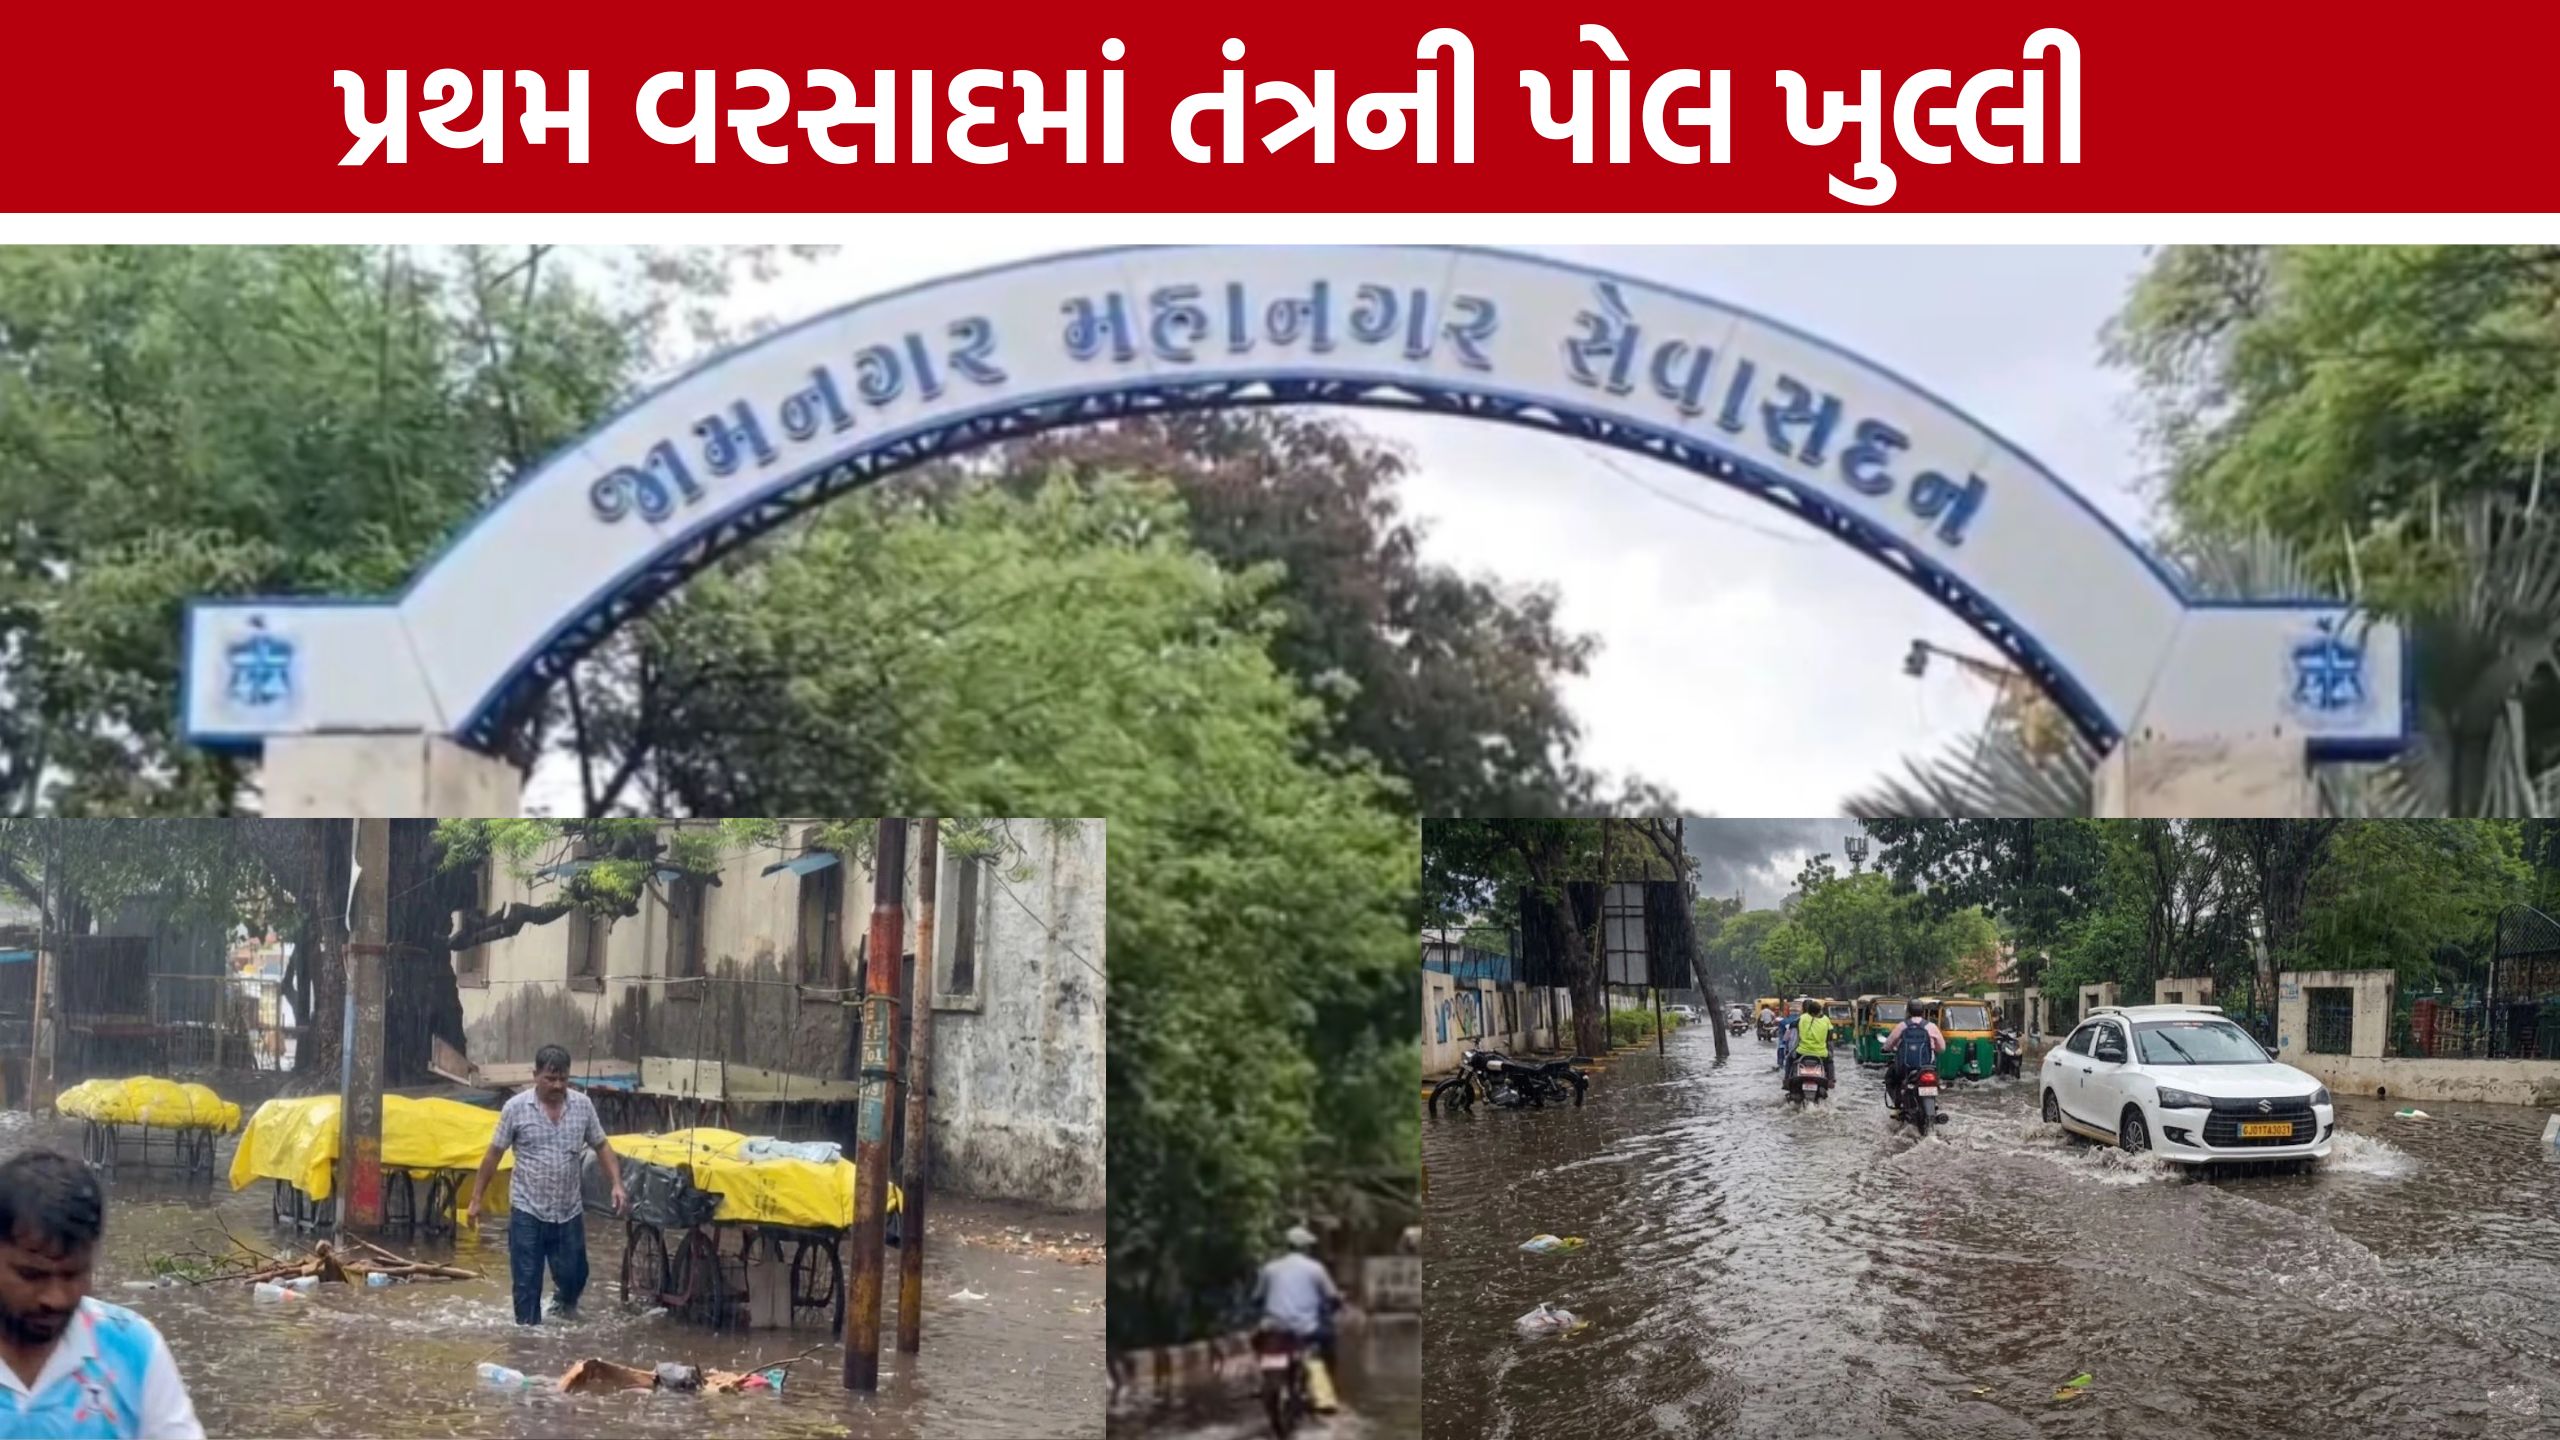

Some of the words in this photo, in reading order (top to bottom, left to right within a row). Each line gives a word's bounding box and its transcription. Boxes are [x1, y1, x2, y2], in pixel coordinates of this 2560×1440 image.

[589, 316, 1007, 523] જામનગર
[1061, 280, 1499, 371] મહાનગર
[1561, 281, 1988, 547] સેવાસદન
